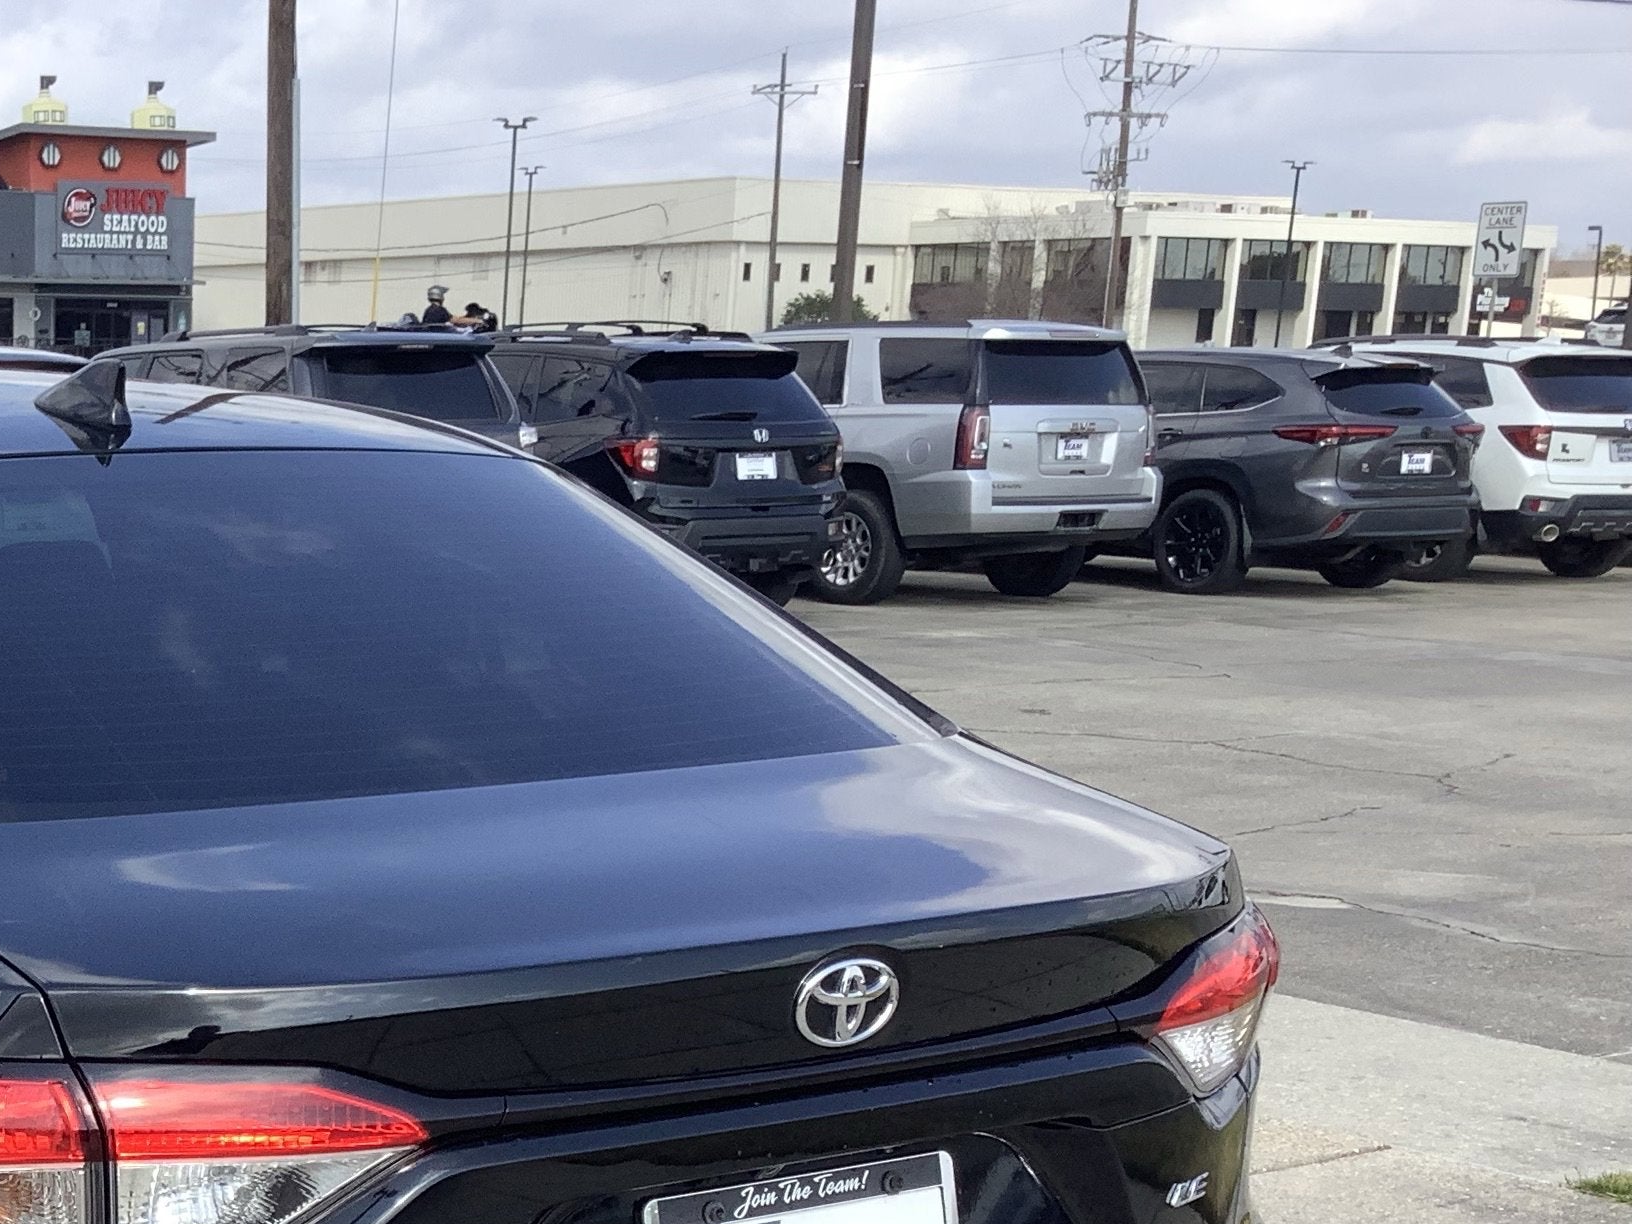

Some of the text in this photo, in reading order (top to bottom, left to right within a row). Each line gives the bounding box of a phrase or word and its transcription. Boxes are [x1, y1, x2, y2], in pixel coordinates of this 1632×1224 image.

[100, 189, 167, 214] JUICY
[1484, 206, 1523, 216] CENTER
[103, 214, 168, 233] SEAFOOD
[1489, 217, 1515, 226] LANE
[61, 233, 168, 250] RESTAURANT & BAR
[1482, 263, 1509, 273] ONLY
[1064, 439, 1083, 451] TEAM
[1408, 454, 1426, 465] TEAM
[734, 1169, 870, 1219] Join The Team!
[1165, 1171, 1210, 1208] LE
